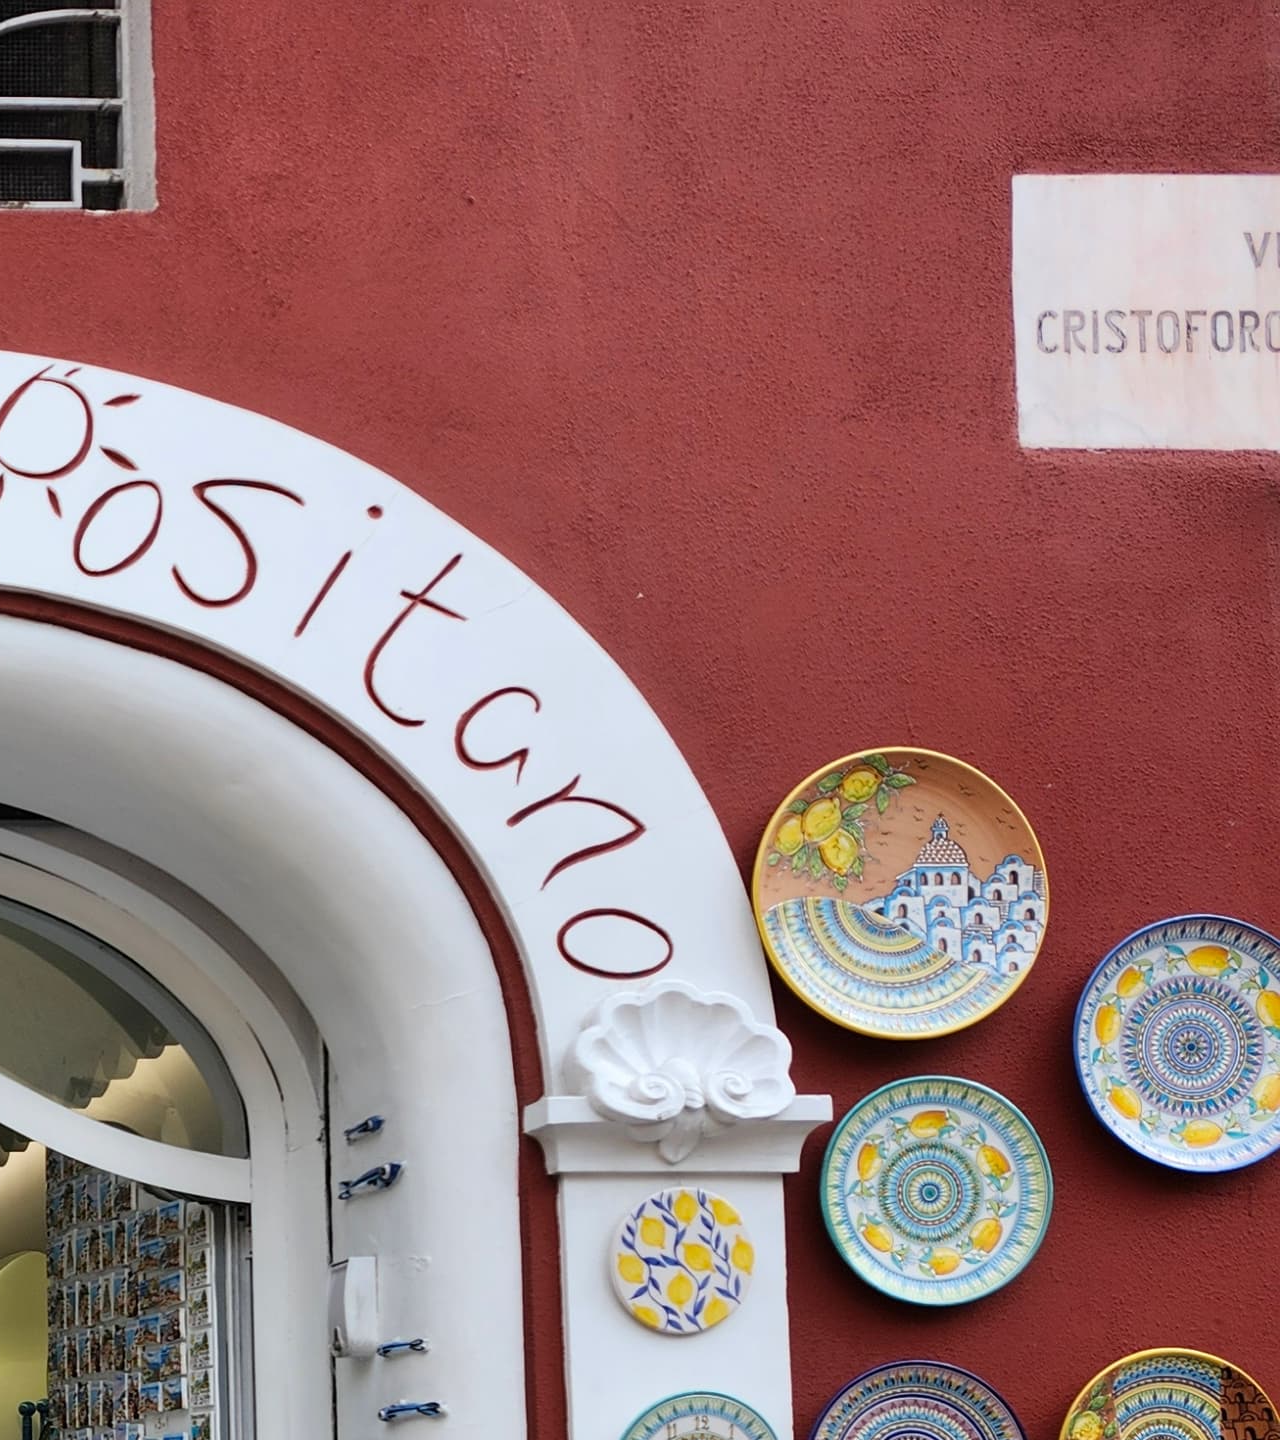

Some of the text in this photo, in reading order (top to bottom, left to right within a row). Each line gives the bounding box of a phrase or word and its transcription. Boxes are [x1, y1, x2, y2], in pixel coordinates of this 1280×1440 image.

[666, 1423, 677, 1440] 11
[694, 1415, 709, 1431] 12
[728, 1423, 735, 1440] 1
